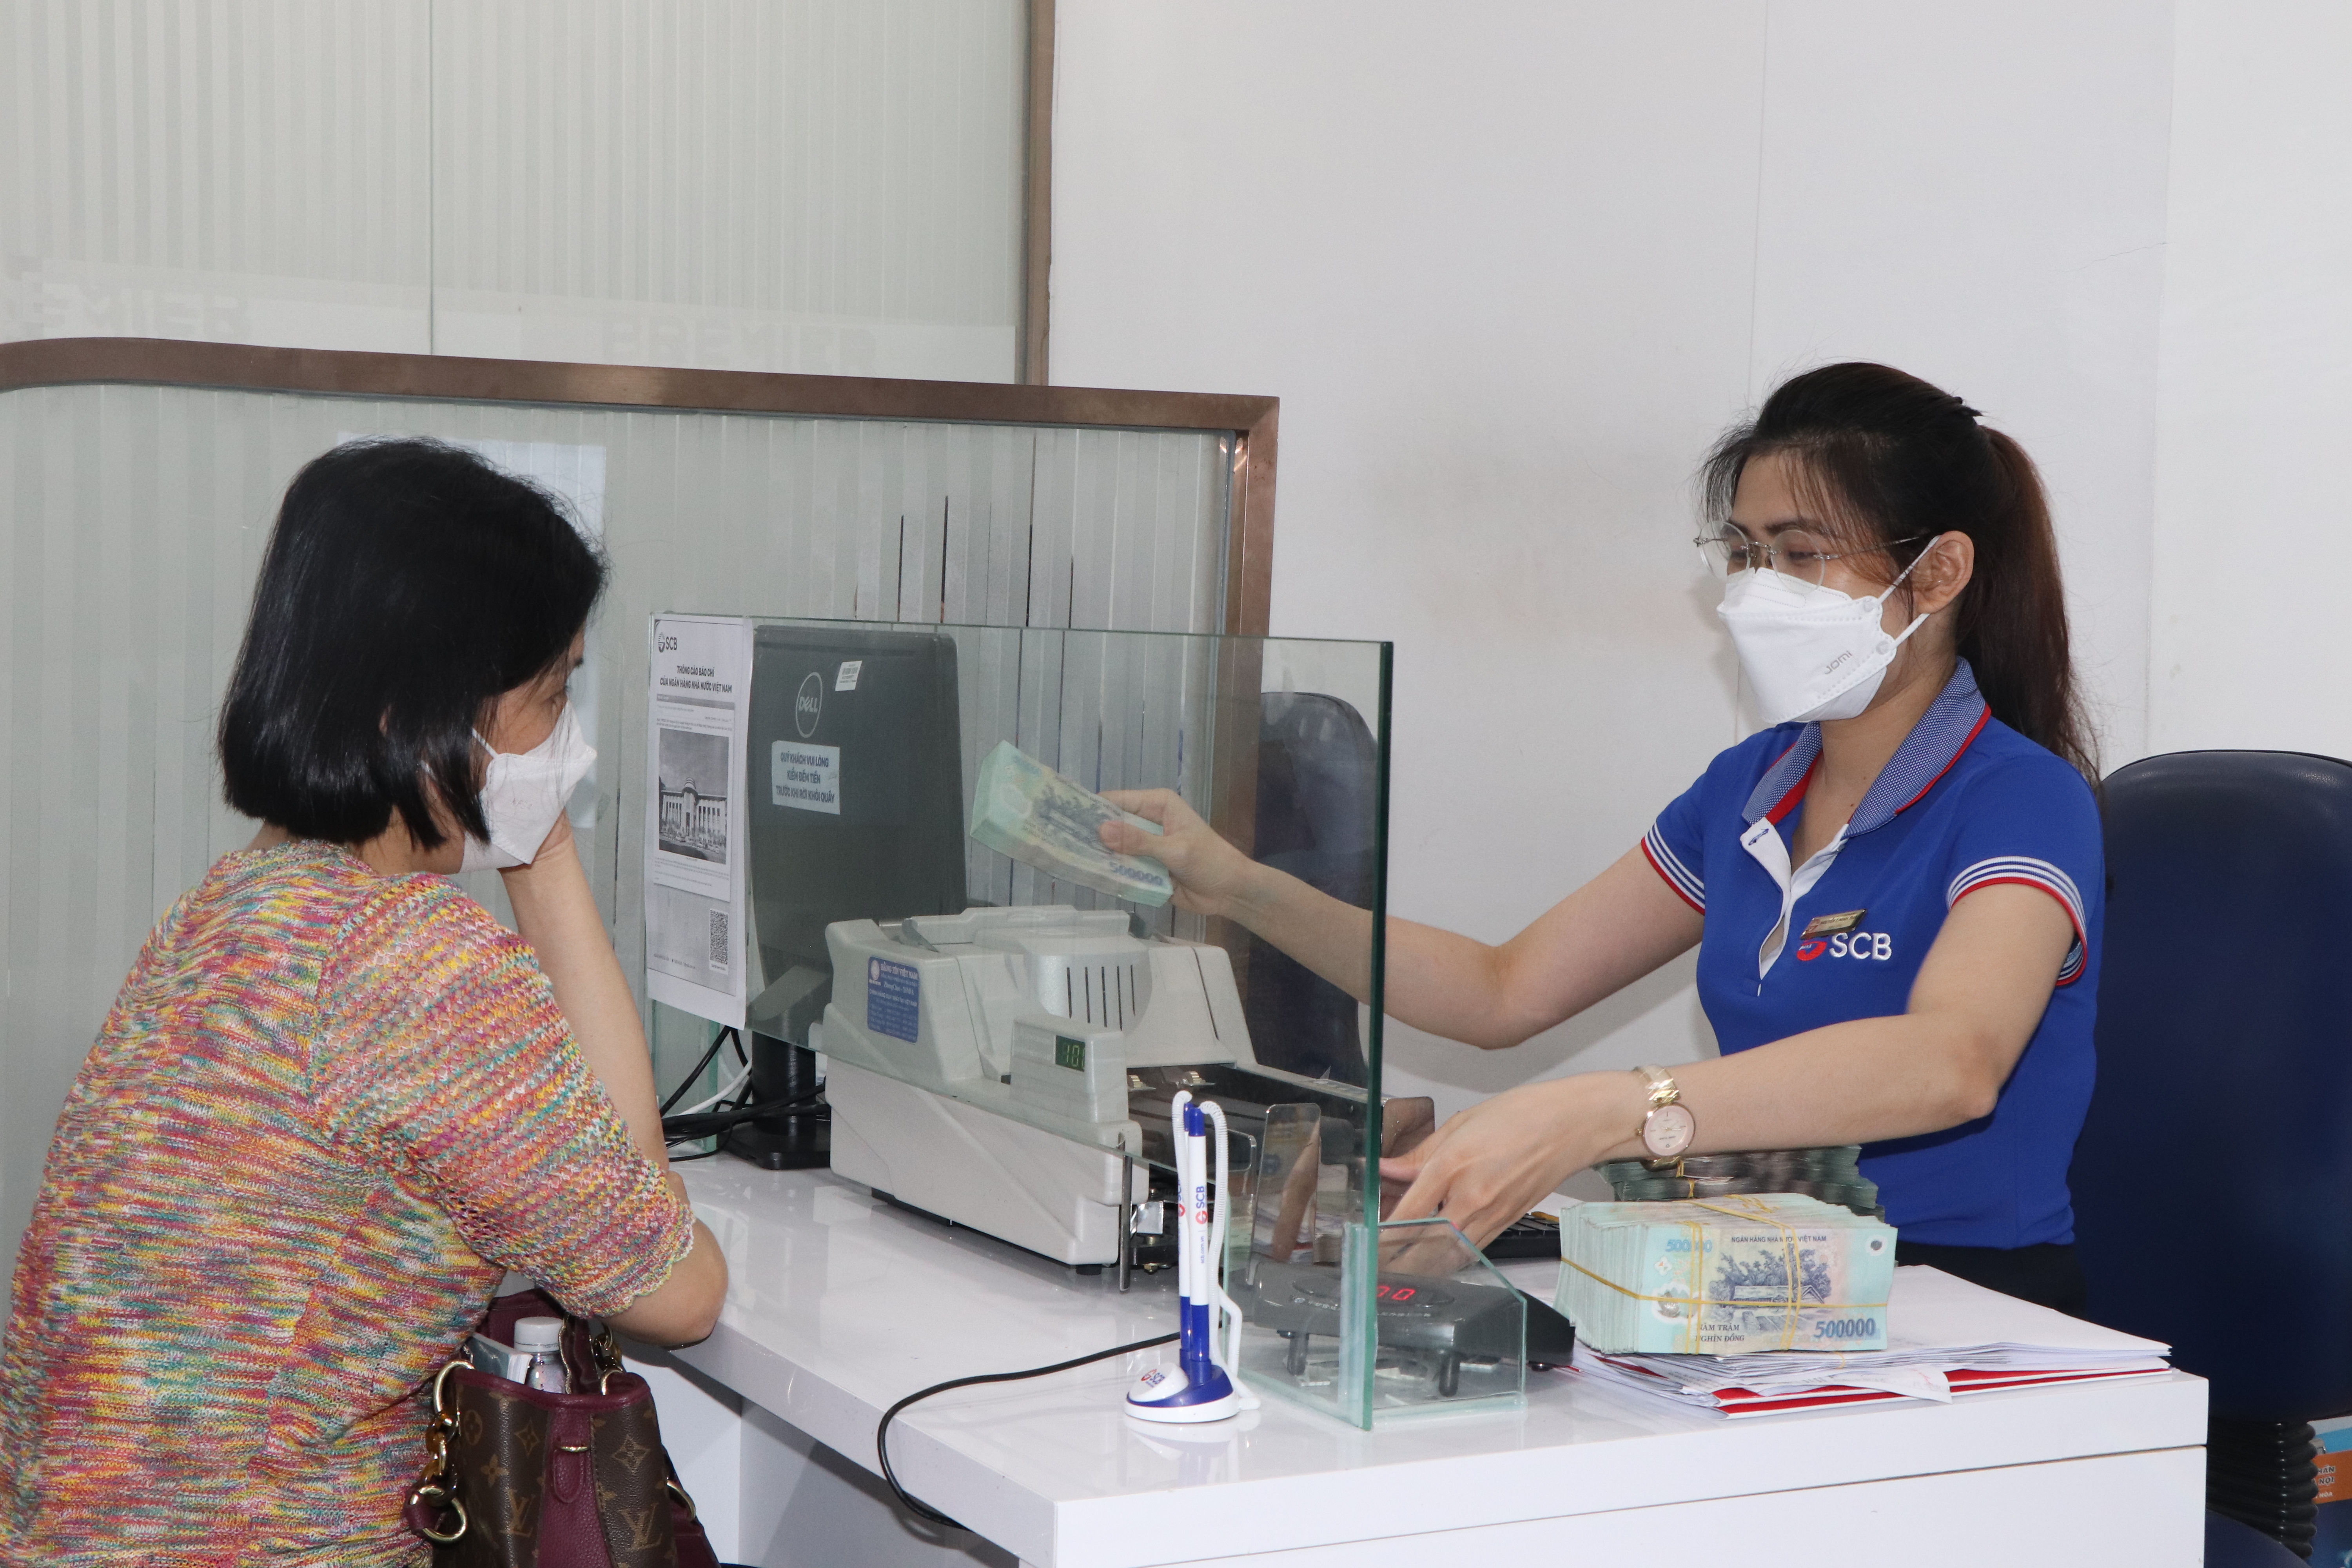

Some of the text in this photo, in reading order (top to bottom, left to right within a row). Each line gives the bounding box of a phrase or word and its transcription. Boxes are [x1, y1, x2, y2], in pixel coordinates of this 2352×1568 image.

[666, 636, 677, 650] SCB
[677, 664, 690, 675] THÔNG
[690, 665, 699, 675] CÁO
[699, 666, 707, 677] BÁO
[660, 675, 732, 694] CỦA NGÂN HÀNG NHÀ NƯỚC VIỆT NAM
[799, 696, 818, 713] DELL
[780, 751, 829, 768] QUÝ KHÁCH VUI LÒNG
[821, 790, 835, 804] QUẦY
[1829, 932, 1892, 961] SCB
[1196, 1186, 1205, 1209] SCB
[1798, 1234, 1811, 1243] VIỆT
[1814, 1318, 1876, 1339] 500000
[1150, 1372, 1165, 1385] SCB
